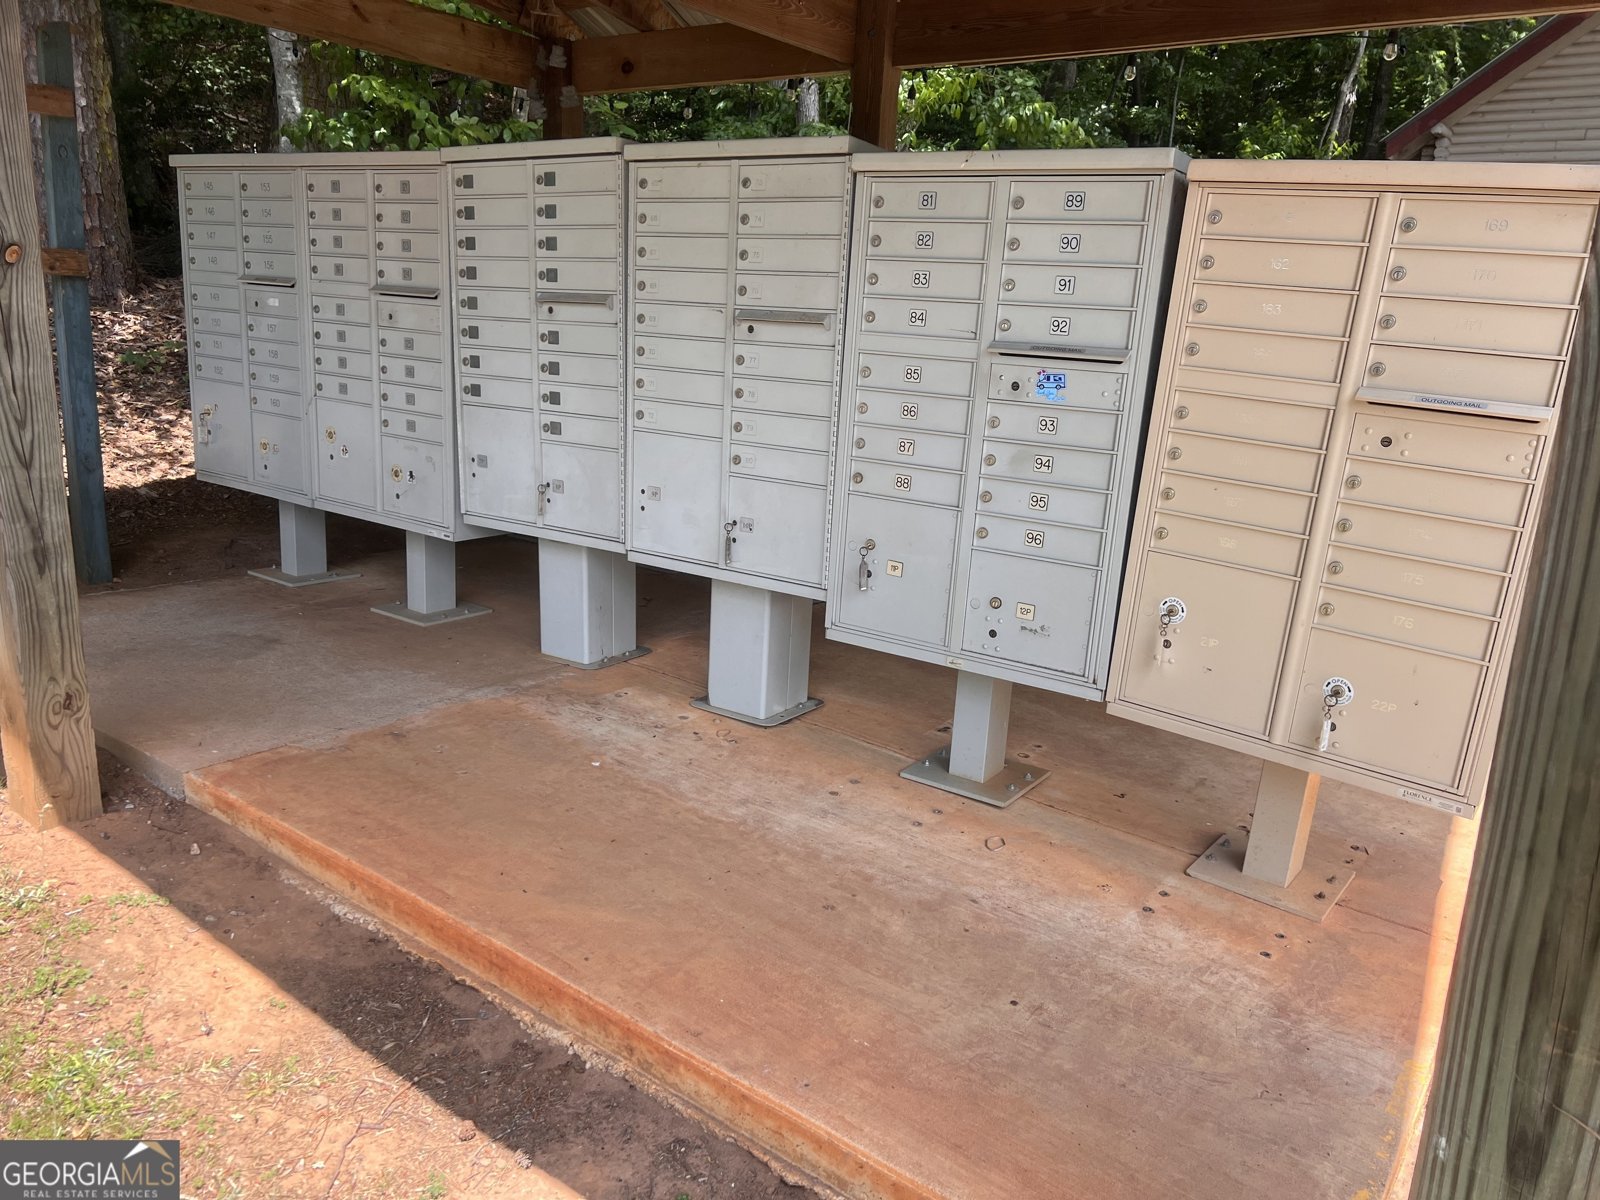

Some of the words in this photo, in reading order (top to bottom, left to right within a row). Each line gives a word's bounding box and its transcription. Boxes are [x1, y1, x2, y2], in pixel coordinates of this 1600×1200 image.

[260, 182, 271, 192] 153
[921, 194, 933, 207] 81
[1065, 194, 1083, 208] 89
[205, 207, 215, 216] 146
[261, 208, 271, 218] 154
[755, 215, 762, 223] 74
[1484, 219, 1509, 232] 169
[917, 233, 931, 247] 82
[1061, 236, 1079, 250] 90
[263, 260, 274, 270] 156
[1270, 258, 1289, 270] 162
[913, 272, 928, 286] 83
[1472, 268, 1497, 281] 170
[1058, 278, 1071, 292] 91
[1262, 303, 1282, 315] 163
[909, 311, 925, 324] 84
[267, 323, 277, 333] 157
[1051, 319, 1068, 333] 92
[268, 349, 278, 359] 158
[749, 356, 757, 364] 77
[905, 367, 920, 381] 85
[1421, 397, 1462, 407] OUTGOING
[902, 405, 917, 417] 86
[1039, 418, 1056, 432] 93
[899, 441, 913, 453] 87
[1035, 457, 1051, 471] 94
[895, 477, 910, 490] 88
[1030, 495, 1047, 509] 95
[1026, 532, 1043, 546] 96
[890, 564, 899, 572] 11P
[1403, 572, 1425, 586] 175
[1168, 598, 1183, 607] OPEN
[1019, 606, 1031, 616] 12P
[1393, 615, 1415, 629] 176
[1331, 678, 1348, 687] OPEN
[1371, 699, 1397, 712] 22P
